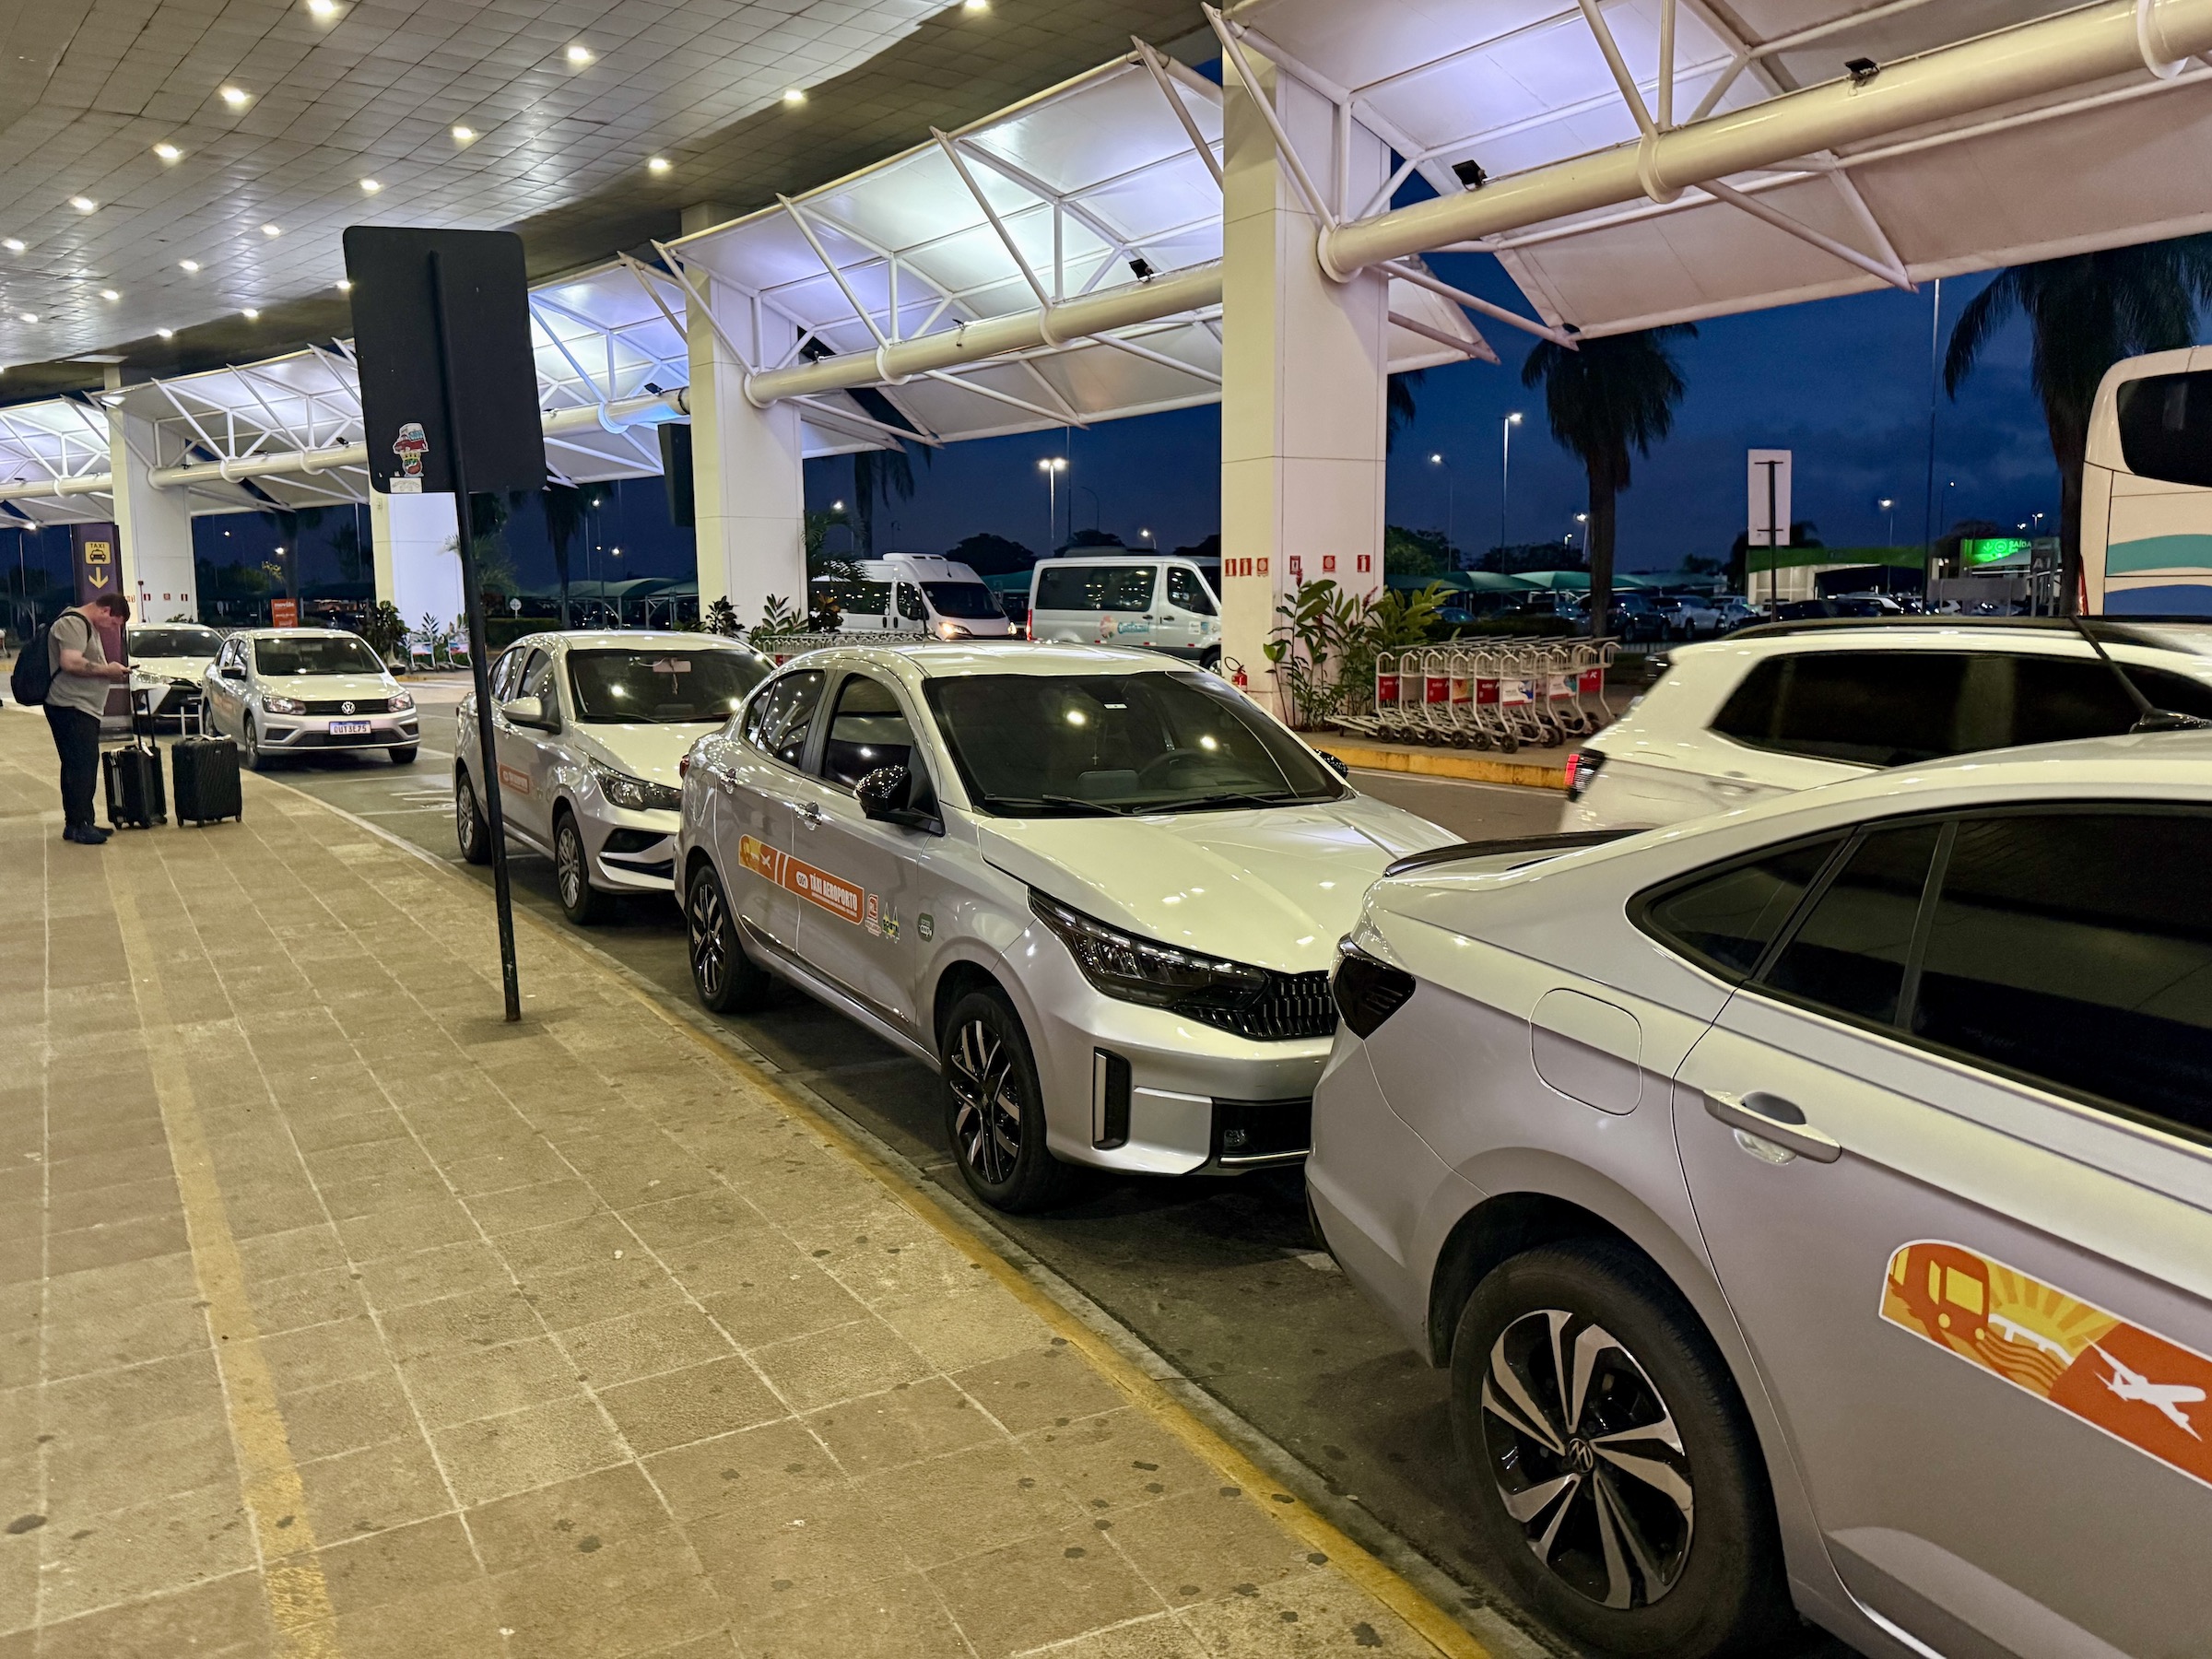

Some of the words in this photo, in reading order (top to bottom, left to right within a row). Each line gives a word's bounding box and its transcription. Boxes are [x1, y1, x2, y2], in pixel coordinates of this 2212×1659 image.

[2009, 539, 2031, 548] SAÍDA
[809, 873, 822, 895] TÁXI
[822, 879, 858, 912] AEROPORTO
